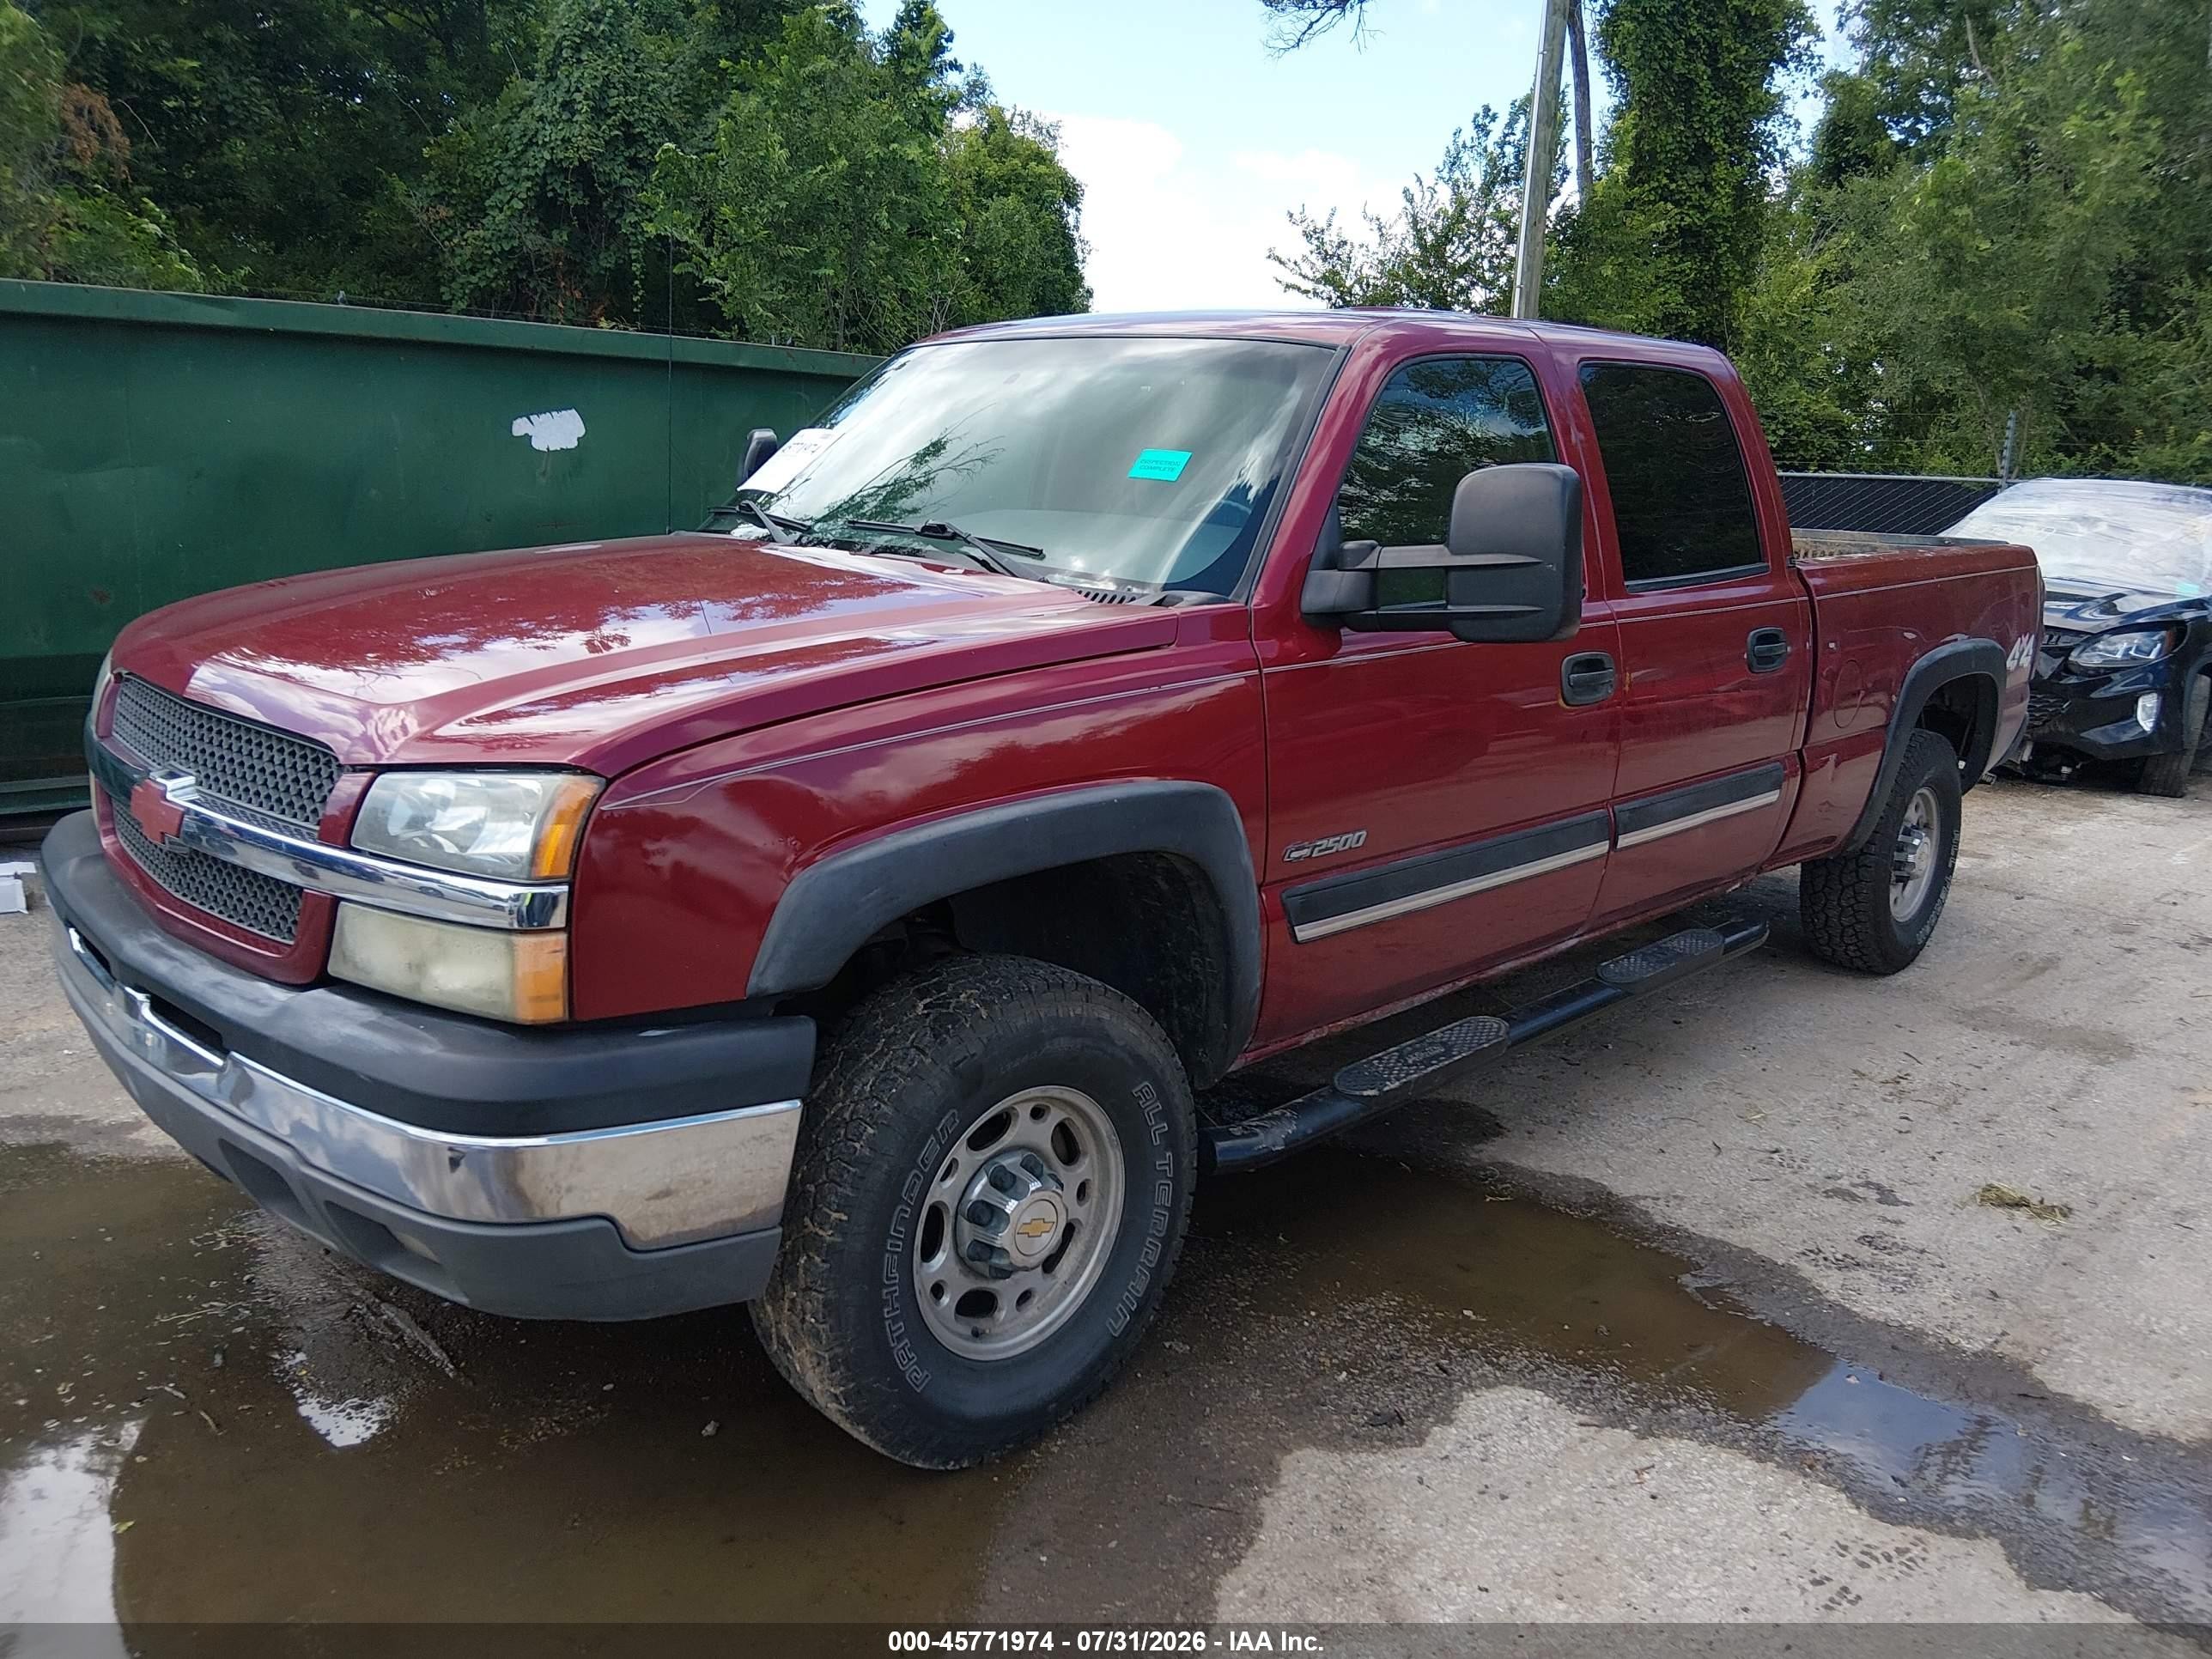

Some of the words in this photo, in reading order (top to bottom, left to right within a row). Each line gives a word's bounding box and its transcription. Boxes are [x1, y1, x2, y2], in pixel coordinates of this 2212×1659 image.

[1139, 465, 1176, 473] COMPLETE
[1310, 830, 1368, 858] 2500
[1131, 1080, 1169, 1146] ALL
[883, 1108, 960, 1393] PATHFINDER
[1106, 1152, 1174, 1338] TERRAIN
